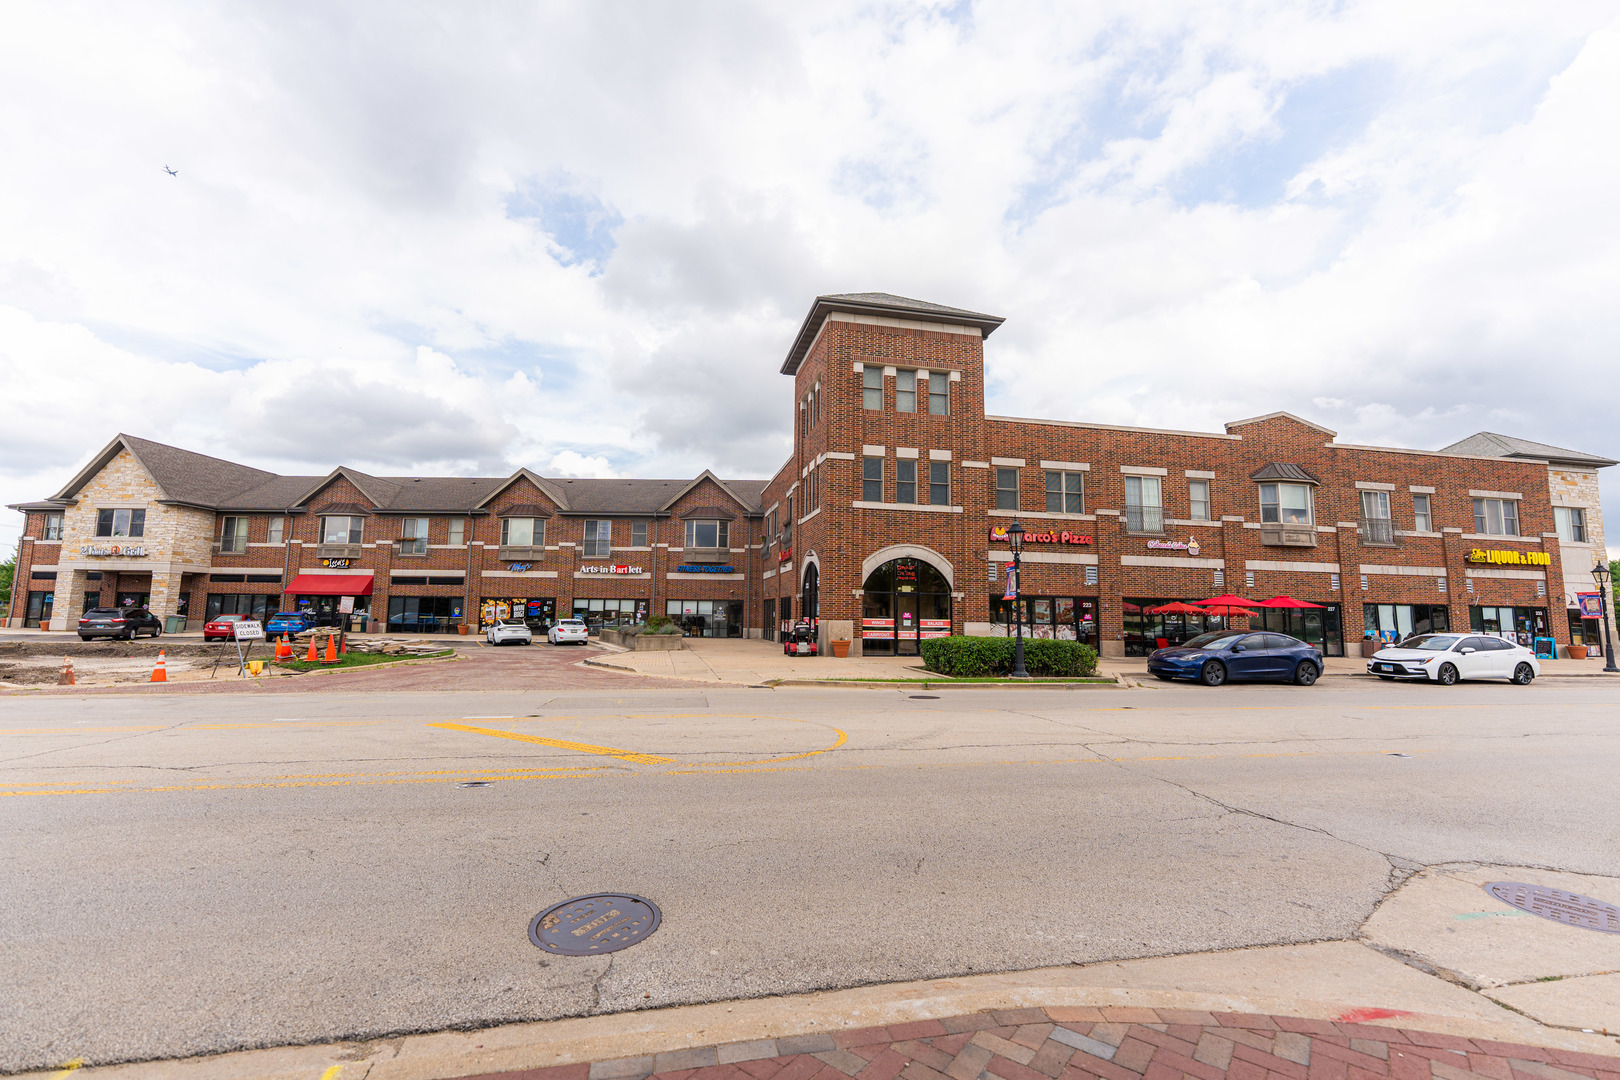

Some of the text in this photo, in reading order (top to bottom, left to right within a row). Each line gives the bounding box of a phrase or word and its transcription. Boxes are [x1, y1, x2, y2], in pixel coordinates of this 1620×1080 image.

[1061, 531, 1093, 544] Pizza
[122, 546, 144, 556] Grill
[1486, 550, 1551, 565] LIQUOR & FOOD
[580, 565, 642, 574] Arts in Bartlett
[677, 565, 734, 573] FITNESS TOGETHER
